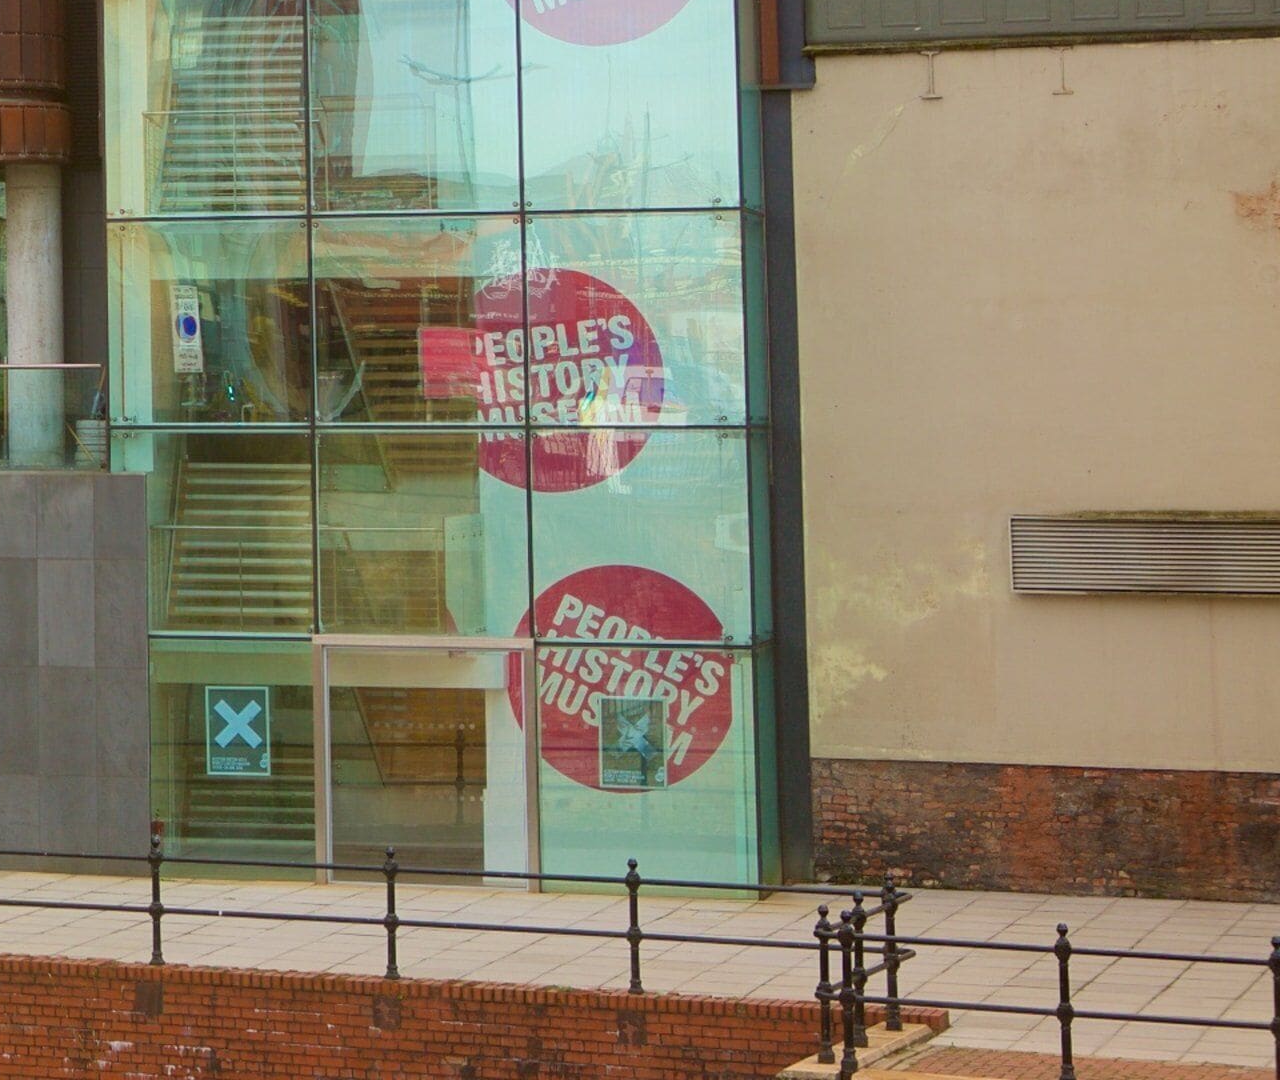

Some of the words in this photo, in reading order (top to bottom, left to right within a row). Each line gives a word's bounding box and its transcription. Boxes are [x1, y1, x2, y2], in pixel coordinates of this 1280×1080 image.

[477, 391, 646, 443] MUSEM
[552, 593, 725, 696] PEOPLE'S
[538, 665, 693, 766] MUSM
